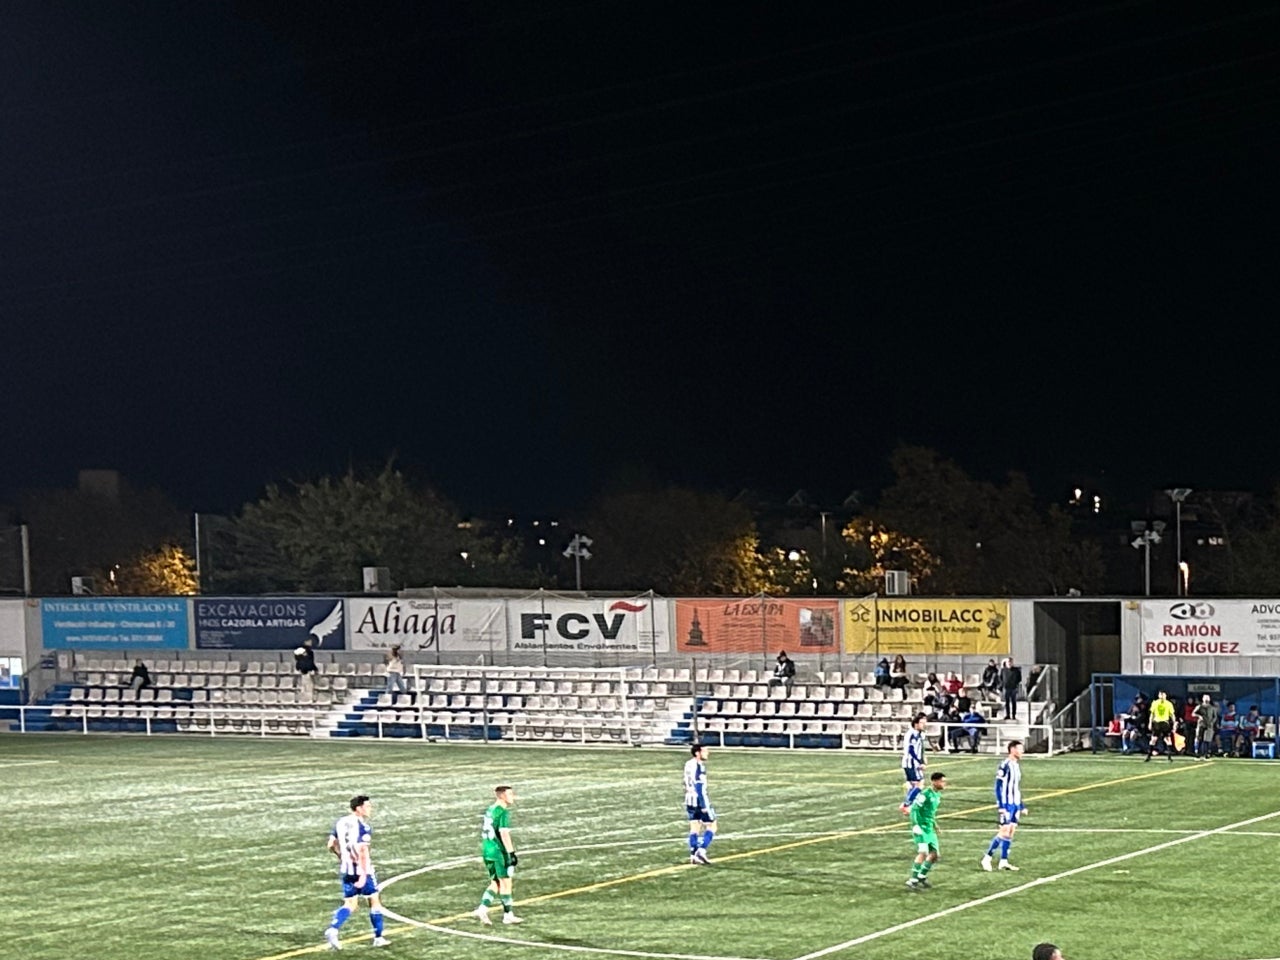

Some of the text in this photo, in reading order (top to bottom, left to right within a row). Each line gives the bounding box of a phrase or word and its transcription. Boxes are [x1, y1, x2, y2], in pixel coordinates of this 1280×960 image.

[44, 602, 92, 612] INTEGRAL
[93, 602, 105, 612] DE
[198, 603, 307, 617] EXCAVACIONS
[876, 609, 983, 623] INMOBILACC
[221, 619, 264, 628] CAZORLA
[265, 619, 306, 627] ARTIGAS
[355, 601, 456, 649] Aliaga
[520, 612, 626, 640] FCV
[1162, 621, 1222, 637] RAMÓN
[1145, 639, 1240, 654] RODRÍGUEZ
